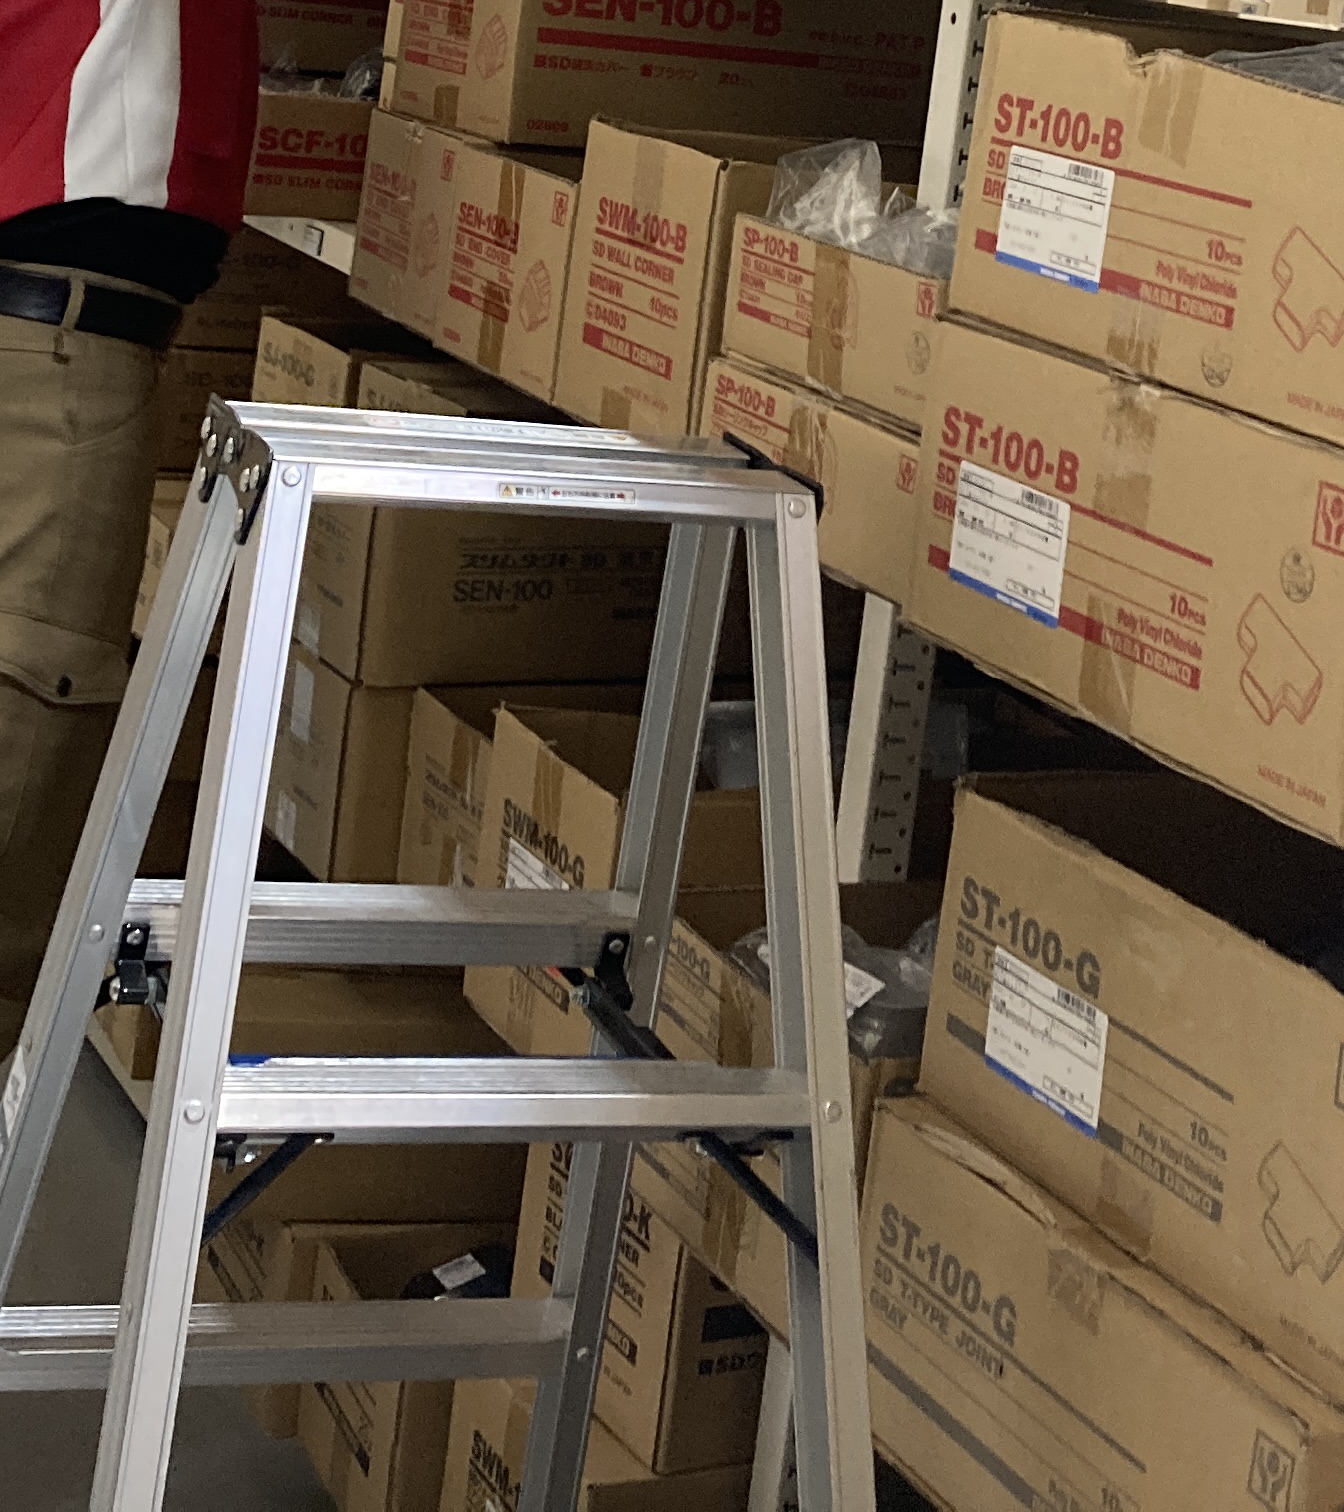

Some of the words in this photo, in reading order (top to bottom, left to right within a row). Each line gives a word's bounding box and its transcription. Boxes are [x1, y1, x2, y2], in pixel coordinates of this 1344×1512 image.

[993, 92, 1125, 160] ST-100-B
[596, 196, 688, 254] SWM-100-B
[743, 226, 799, 263] SP-100-B
[589, 272, 624, 298] BROWN
[634, 254, 675, 286] CORNER
[1180, 293, 1226, 323] DENKO
[715, 374, 776, 419] SP-100-B
[942, 406, 1081, 493] ST-100-B
[1144, 648, 1191, 682] DENKO
[960, 876, 1102, 999] ST-100-G
[879, 1202, 1017, 1347] ST-100-G
[901, 1281, 950, 1335] T-TYPE
[955, 1329, 1004, 1380] JOINT
